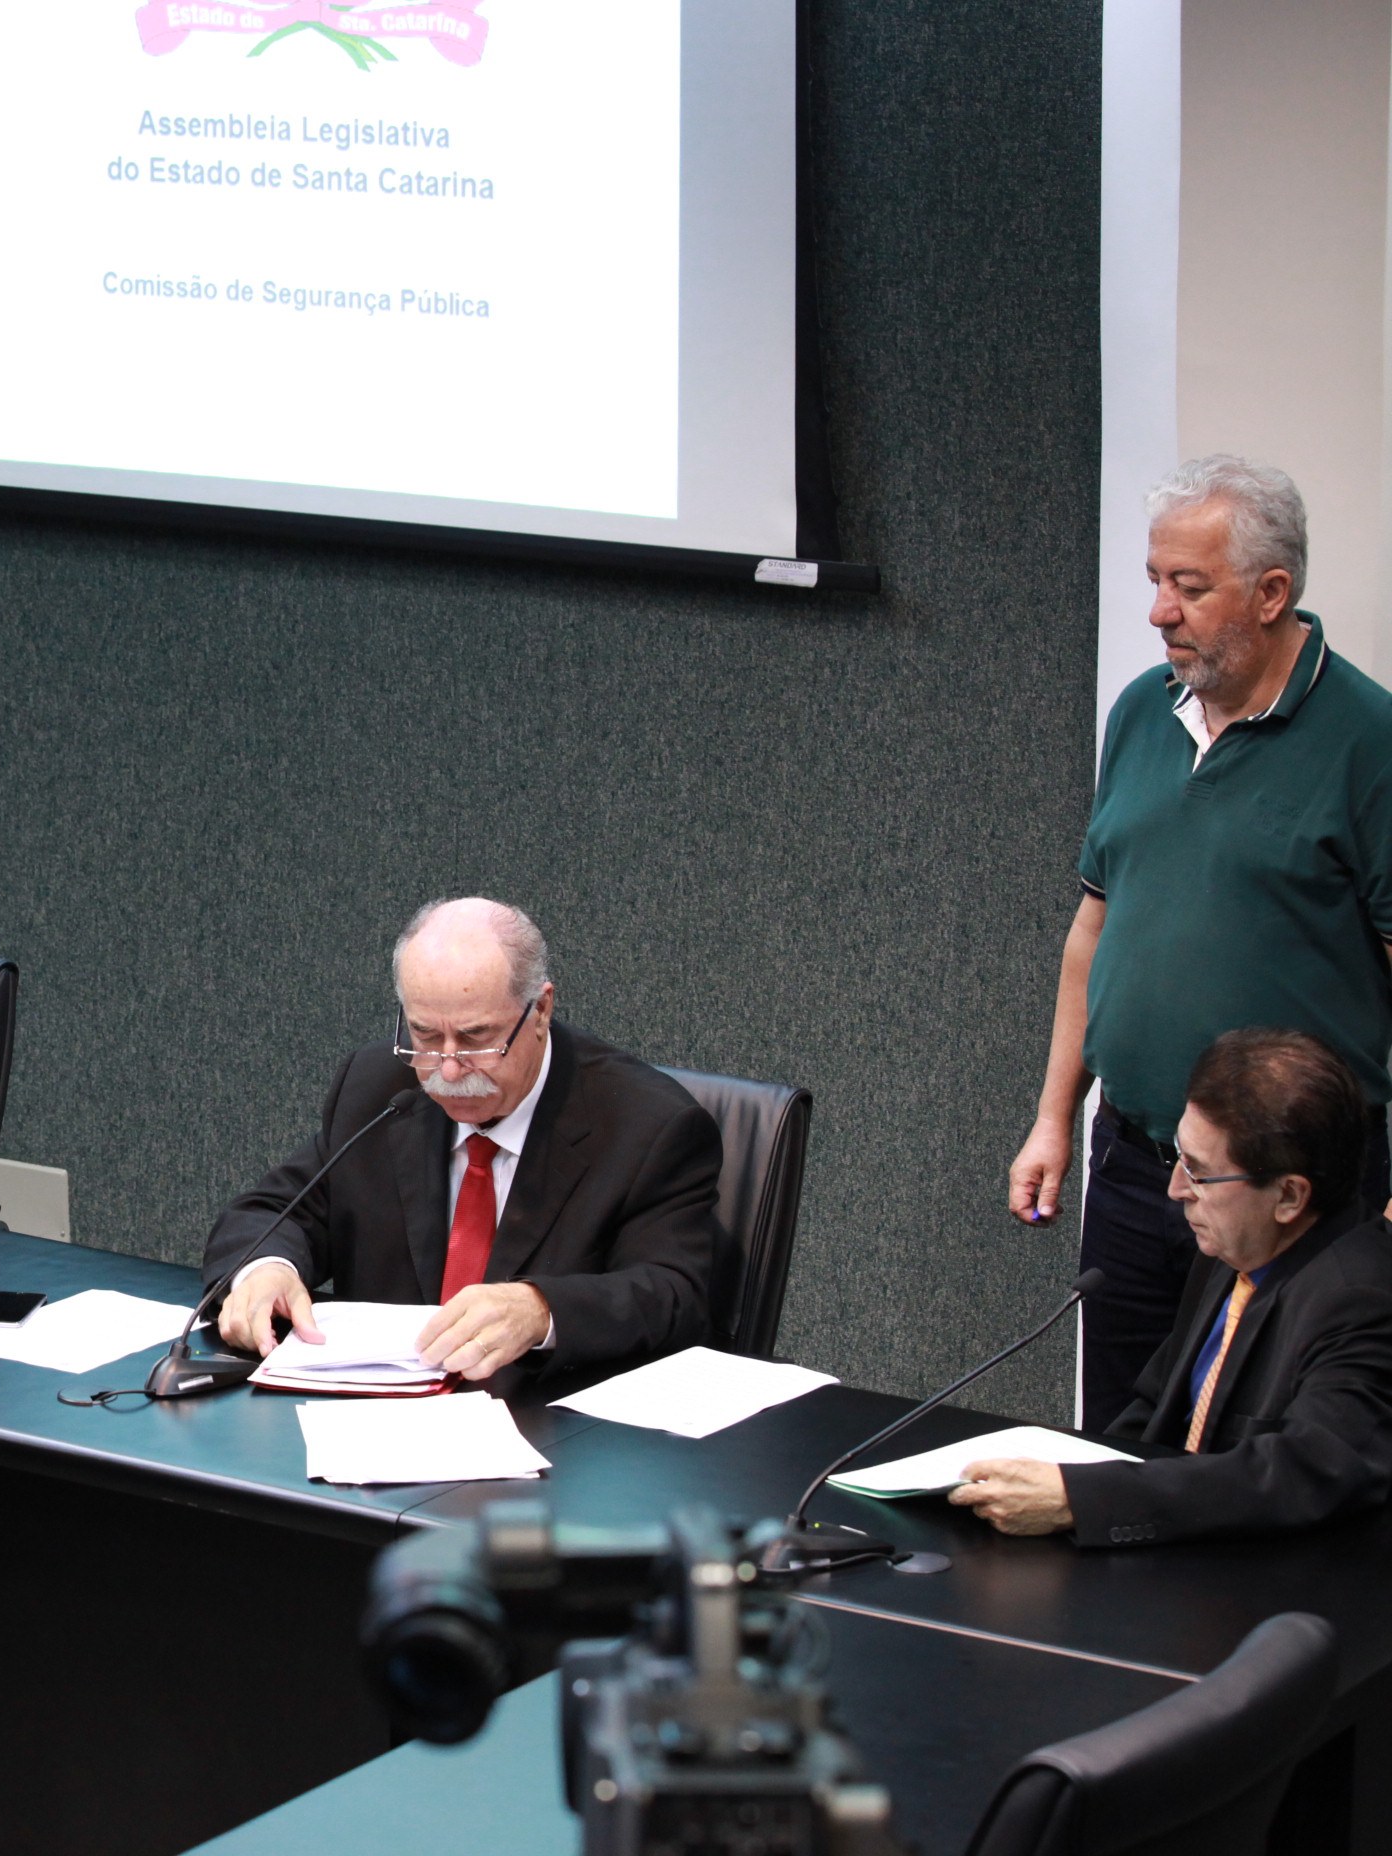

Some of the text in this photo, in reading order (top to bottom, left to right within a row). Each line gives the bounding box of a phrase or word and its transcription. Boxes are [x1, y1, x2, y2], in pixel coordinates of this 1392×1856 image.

[166, 3, 264, 29] Estado de
[338, 12, 471, 40] Sta. Catarina
[138, 110, 450, 151] Assembleia Legislativa
[107, 156, 494, 200] do Estado de Santa Catarina
[103, 271, 489, 318] Comissão de Segurança Pública
